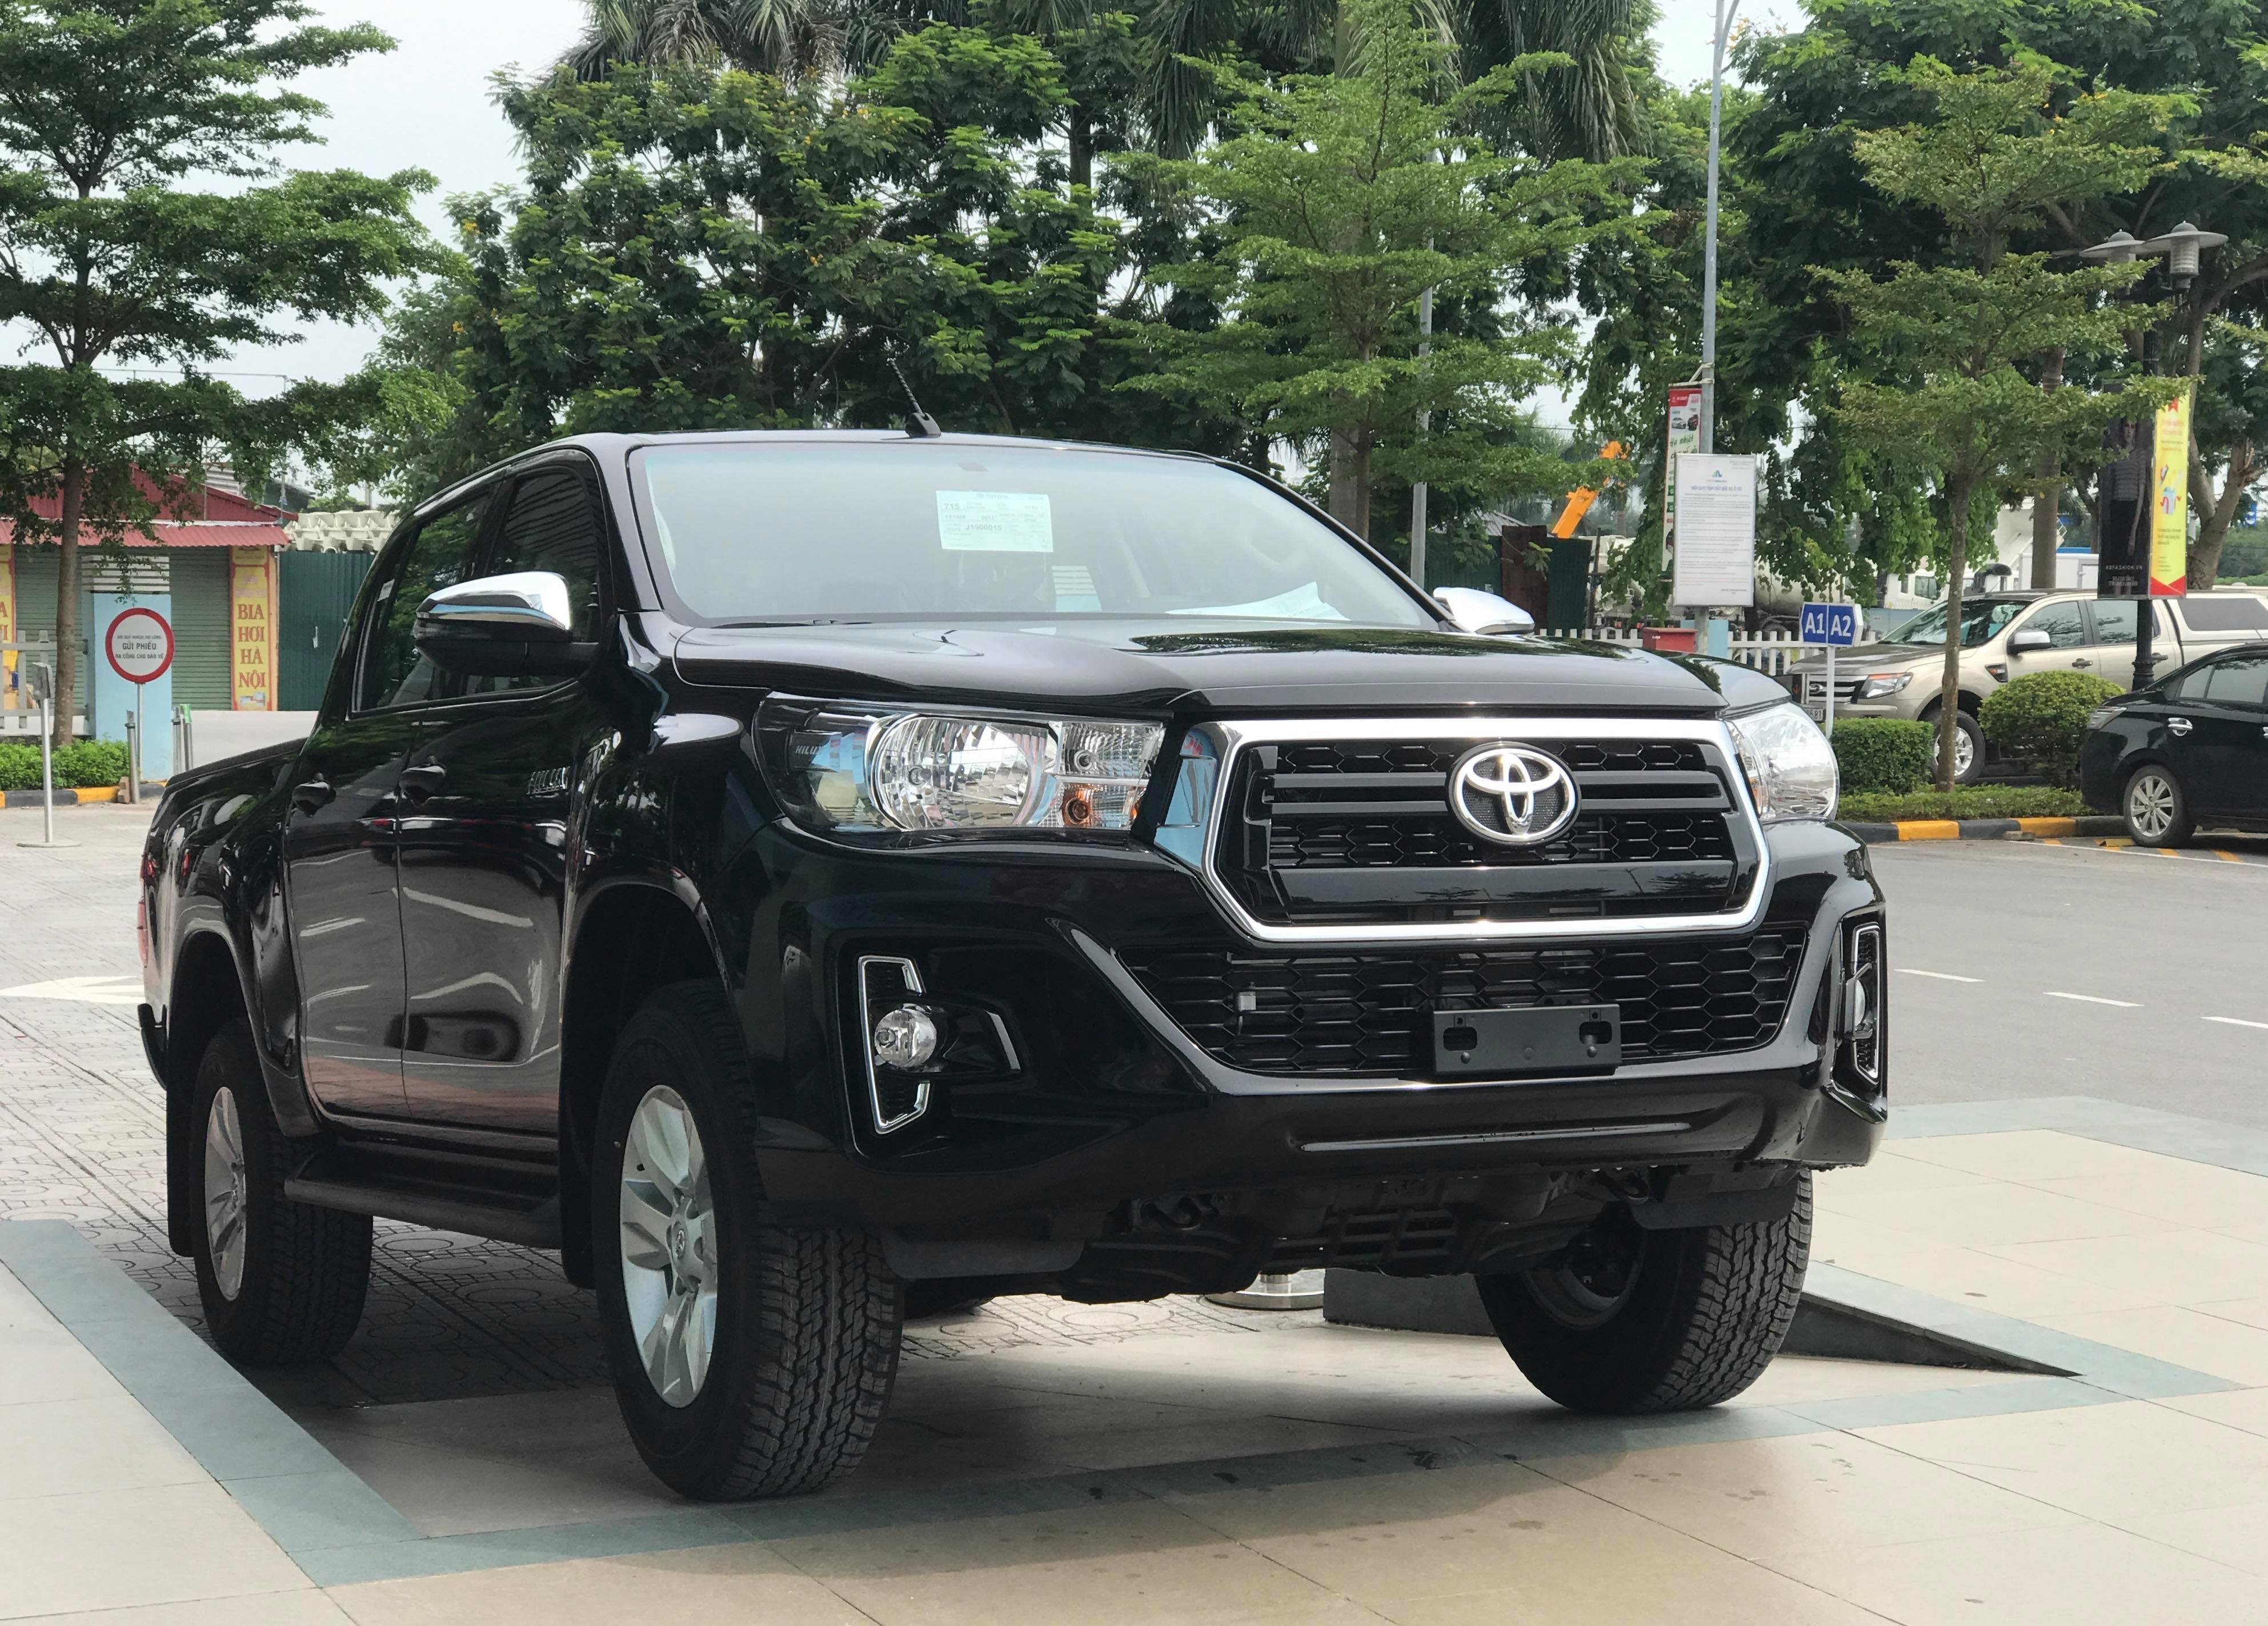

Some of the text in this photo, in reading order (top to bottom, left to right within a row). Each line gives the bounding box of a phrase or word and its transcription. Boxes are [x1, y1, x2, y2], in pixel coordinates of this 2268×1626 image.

[238, 604, 265, 620] BIA
[1805, 612, 1851, 637] A1 A2
[238, 626, 266, 642] HƠI
[241, 646, 263, 664] HÀ
[238, 671, 266, 689] NỘI
